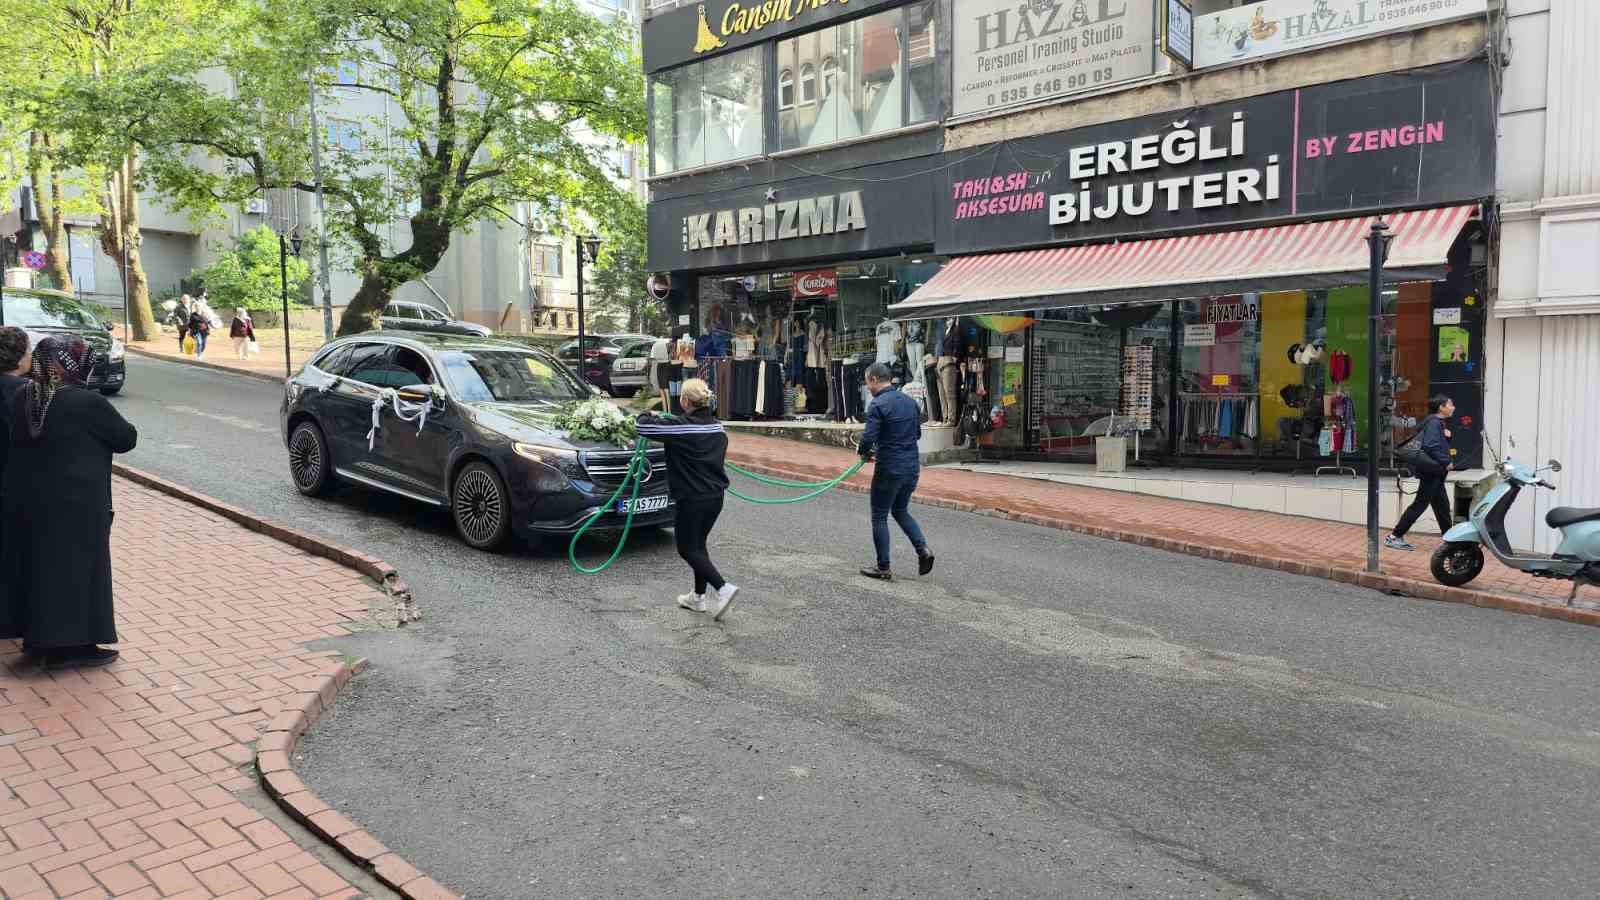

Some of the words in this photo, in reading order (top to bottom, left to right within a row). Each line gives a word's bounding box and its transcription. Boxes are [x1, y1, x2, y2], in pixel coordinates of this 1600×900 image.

[977, 45, 1028, 72] Personel
[1031, 35, 1078, 59] Traning
[1081, 23, 1123, 48] Studio
[987, 94, 996, 106] 0
[1001, 86, 1027, 103] 535
[1033, 79, 1061, 96] 646
[1068, 73, 1086, 88] 90
[1094, 67, 1112, 82] 03
[1069, 111, 1245, 181] EREĞLİ
[1305, 136, 1338, 159] BY
[955, 191, 1046, 220] AKSESUAR
[1049, 154, 1281, 226] BİJUTERİ
